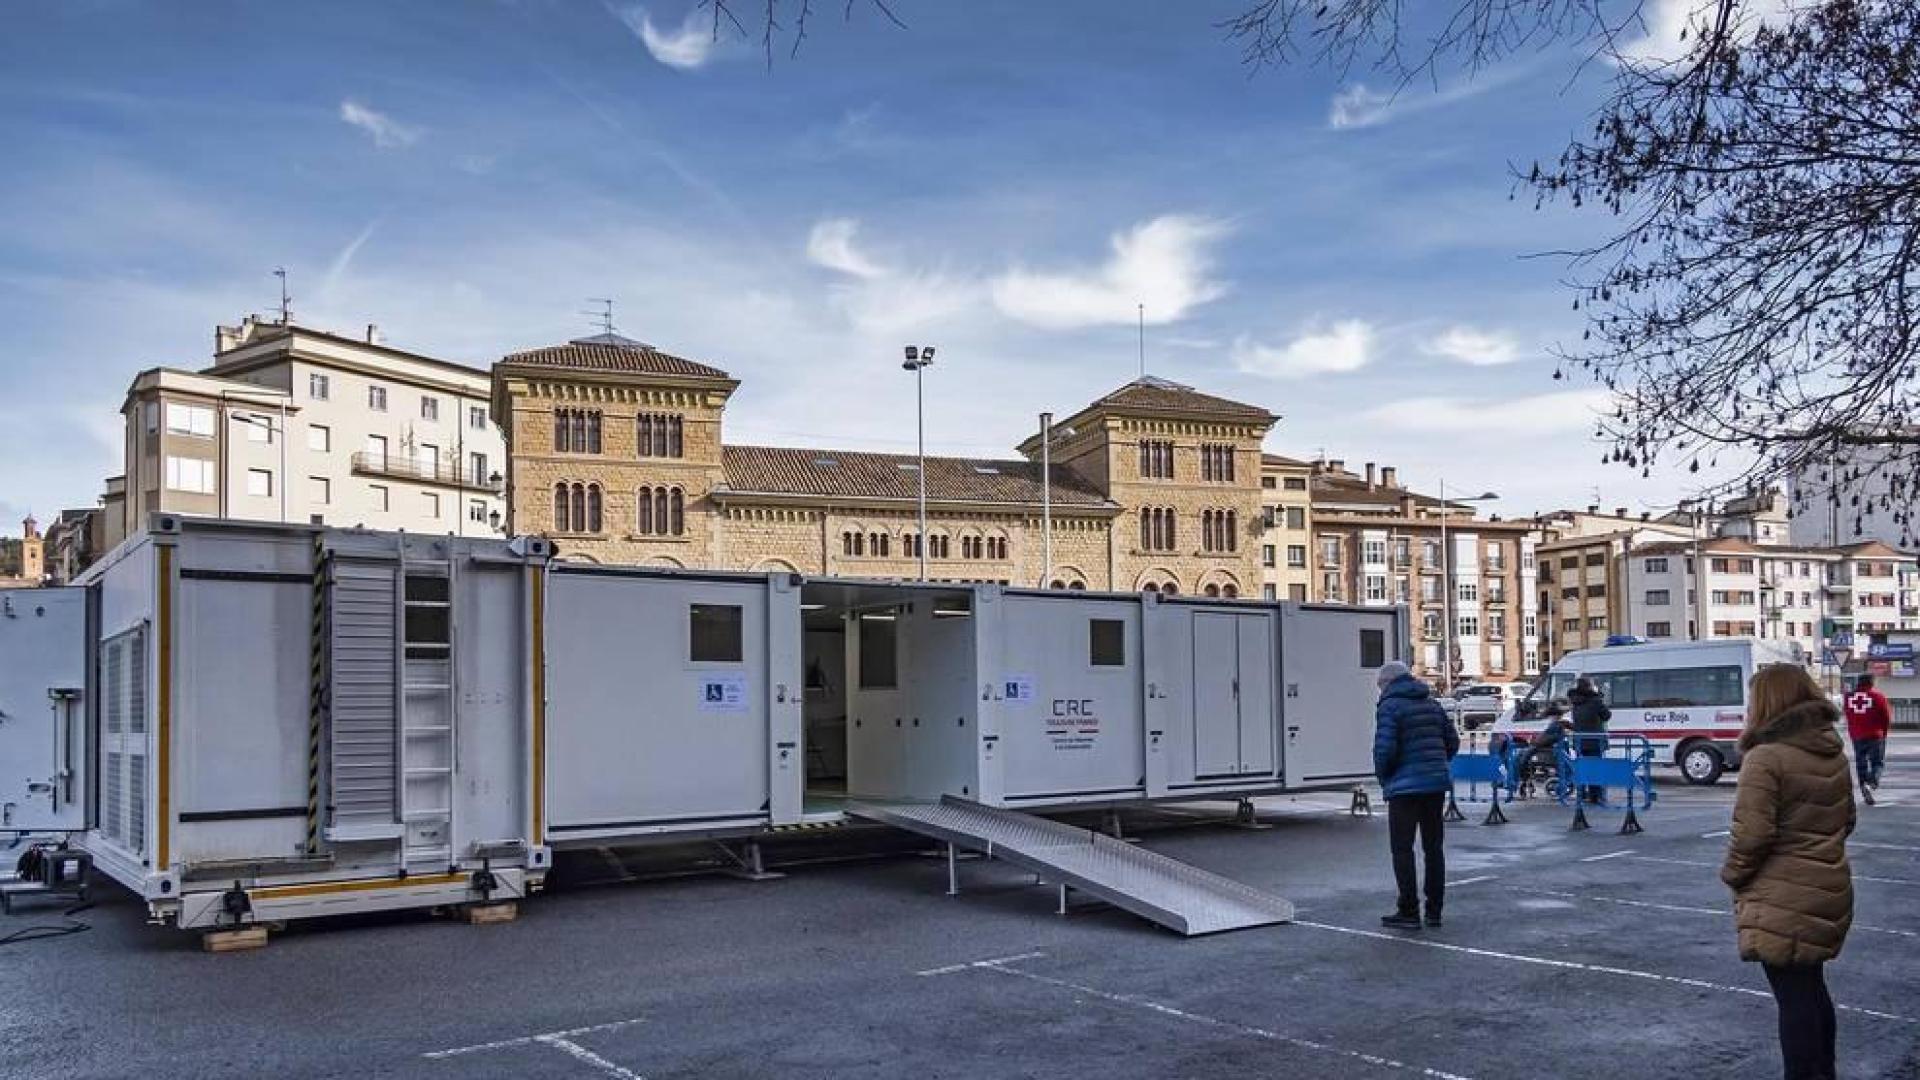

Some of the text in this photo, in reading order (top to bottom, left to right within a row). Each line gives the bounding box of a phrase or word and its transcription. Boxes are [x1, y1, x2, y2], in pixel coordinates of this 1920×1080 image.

[1053, 699, 1093, 716] CRC
[1644, 711, 1690, 724] Cruz Roja
